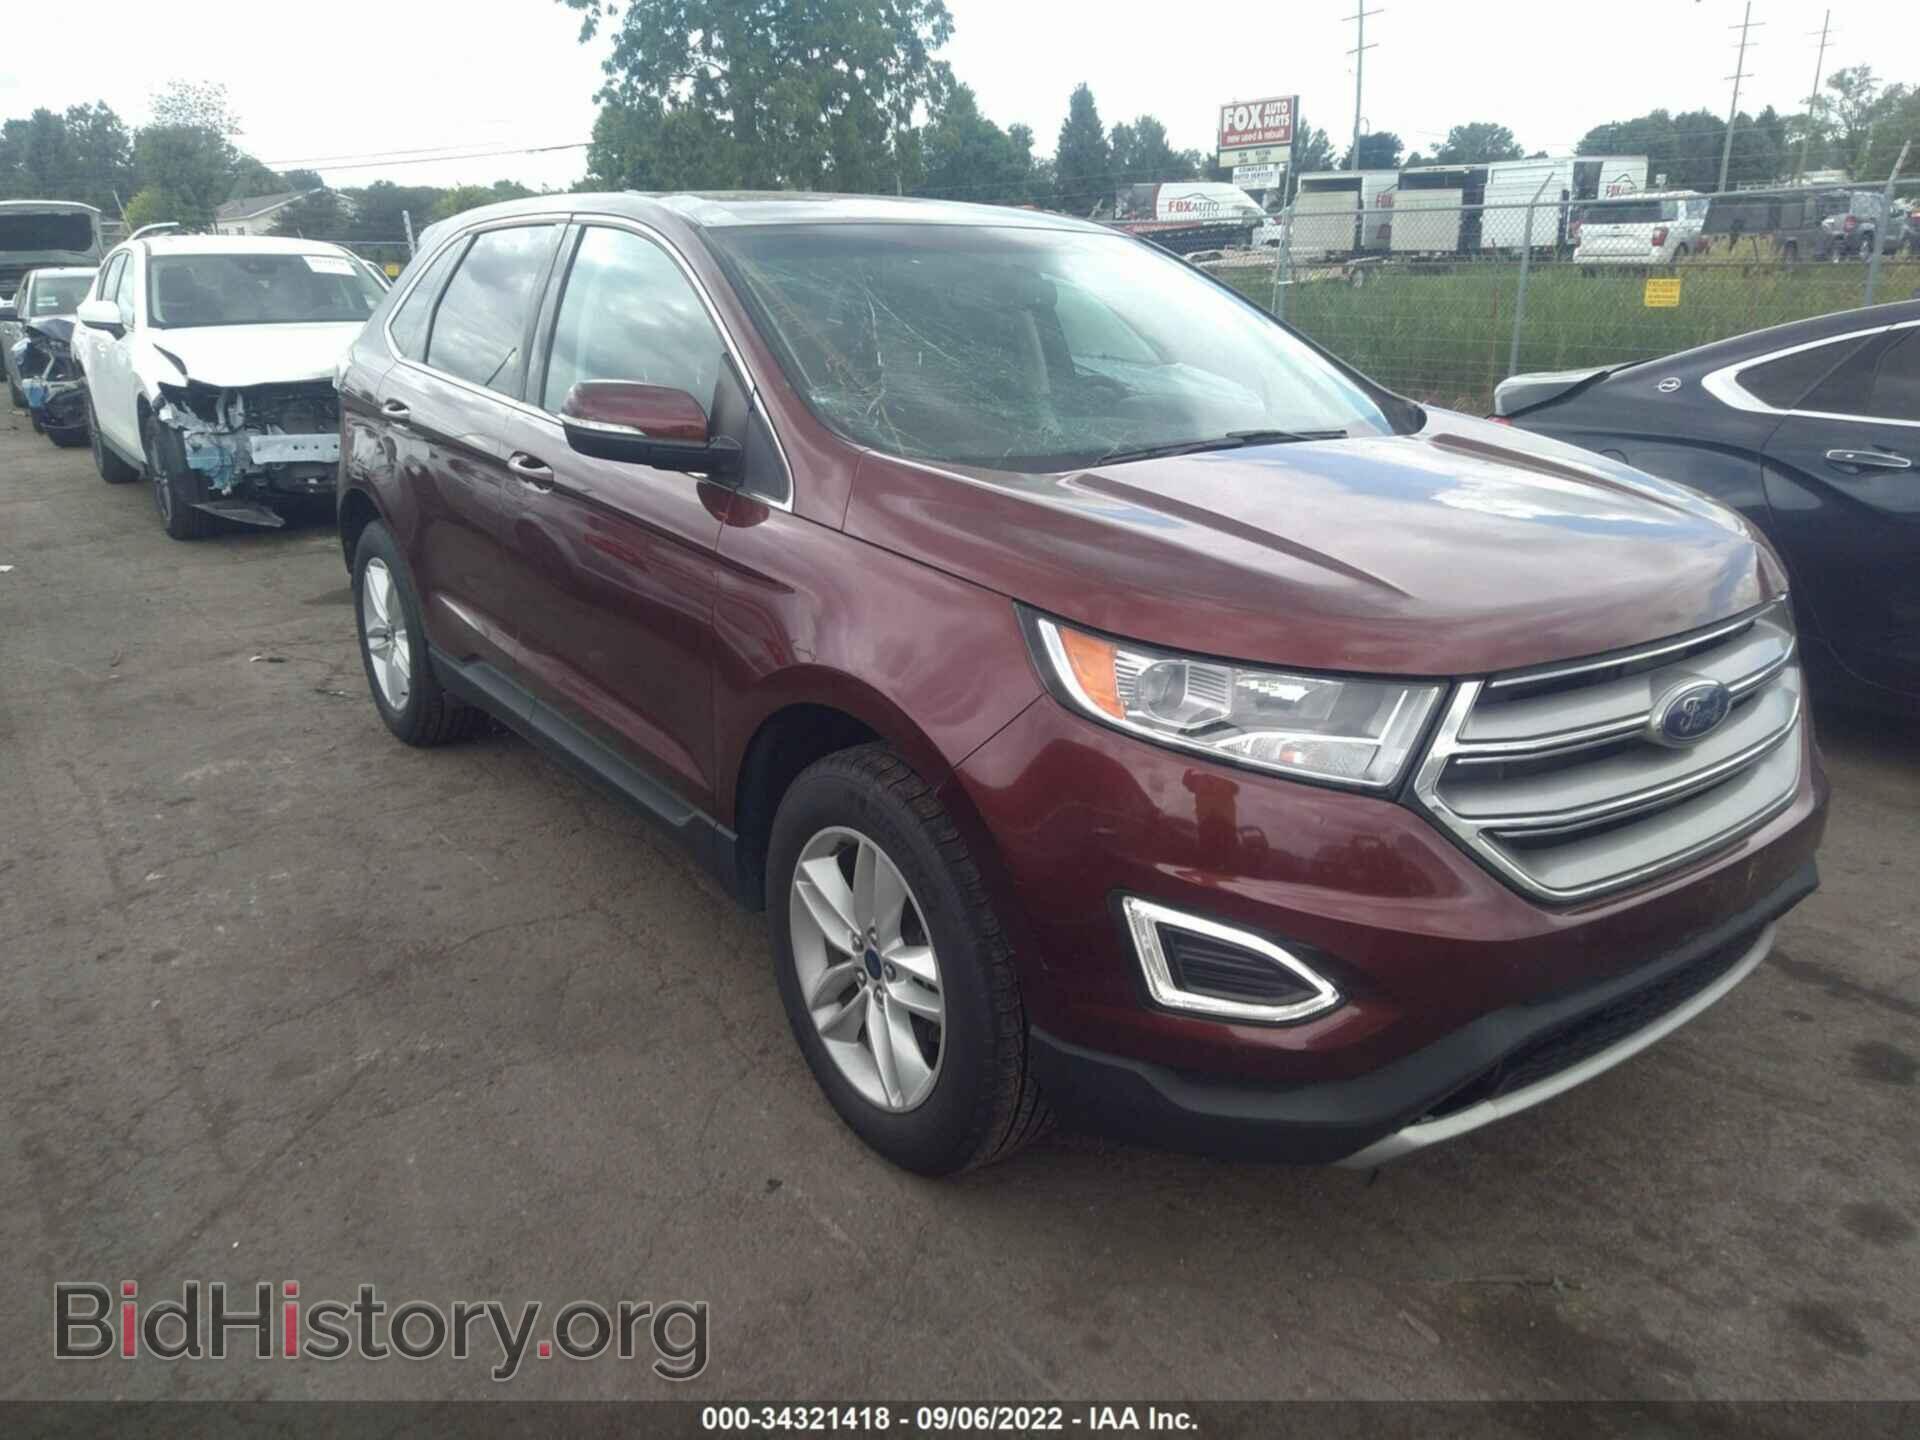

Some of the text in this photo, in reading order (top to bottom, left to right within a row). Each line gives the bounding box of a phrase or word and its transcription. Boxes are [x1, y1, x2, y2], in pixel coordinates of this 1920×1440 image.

[1264, 101, 1288, 115] AUTO
[1223, 104, 1263, 132] FOX
[1264, 113, 1290, 128] PARTS
[1256, 130, 1263, 140] &
